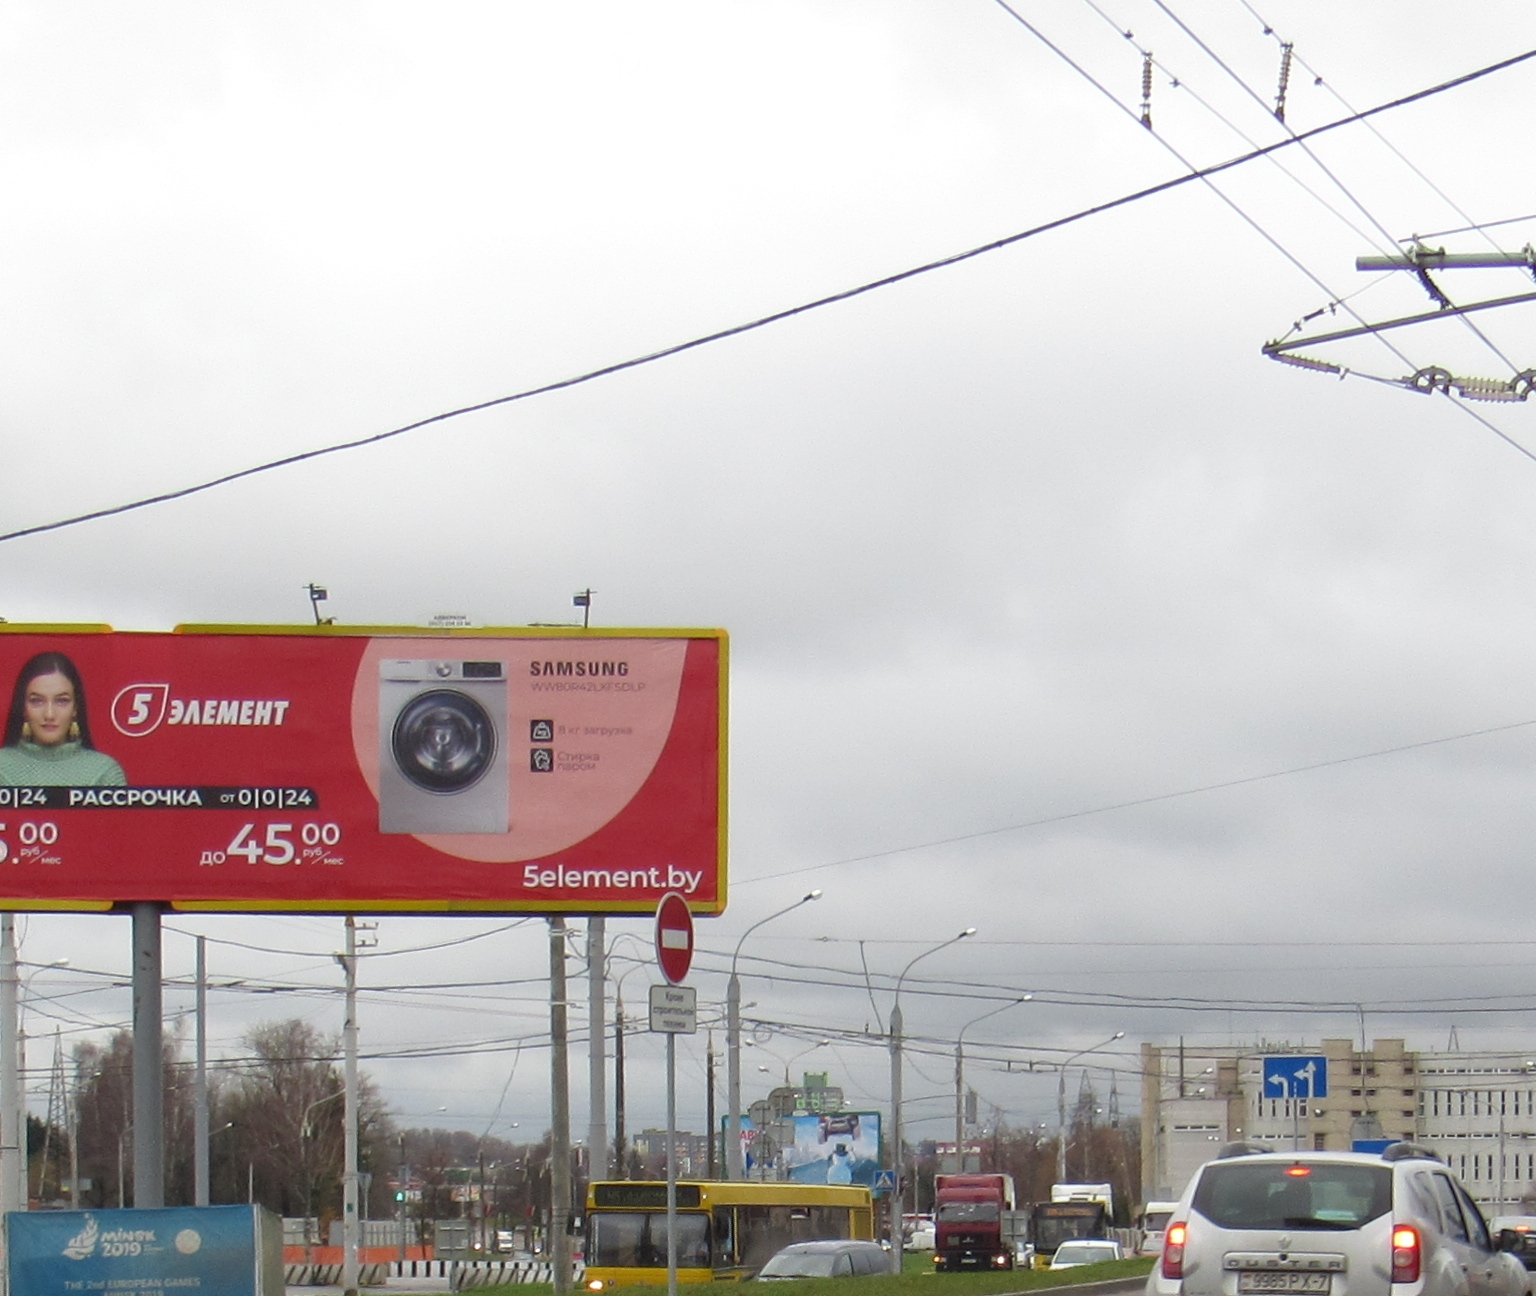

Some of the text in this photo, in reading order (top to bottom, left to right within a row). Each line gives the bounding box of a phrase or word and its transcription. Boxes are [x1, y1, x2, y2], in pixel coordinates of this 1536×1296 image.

[530, 661, 629, 676] SAMSUNG
[128, 693, 290, 726] 5 ЭЛЕМЕНТ
[69, 789, 203, 806] РАССРОЧКА
[523, 865, 703, 894] 5element.by
[102, 1242, 142, 1257] 2019
[1228, 1260, 1341, 1268] DUSTER
